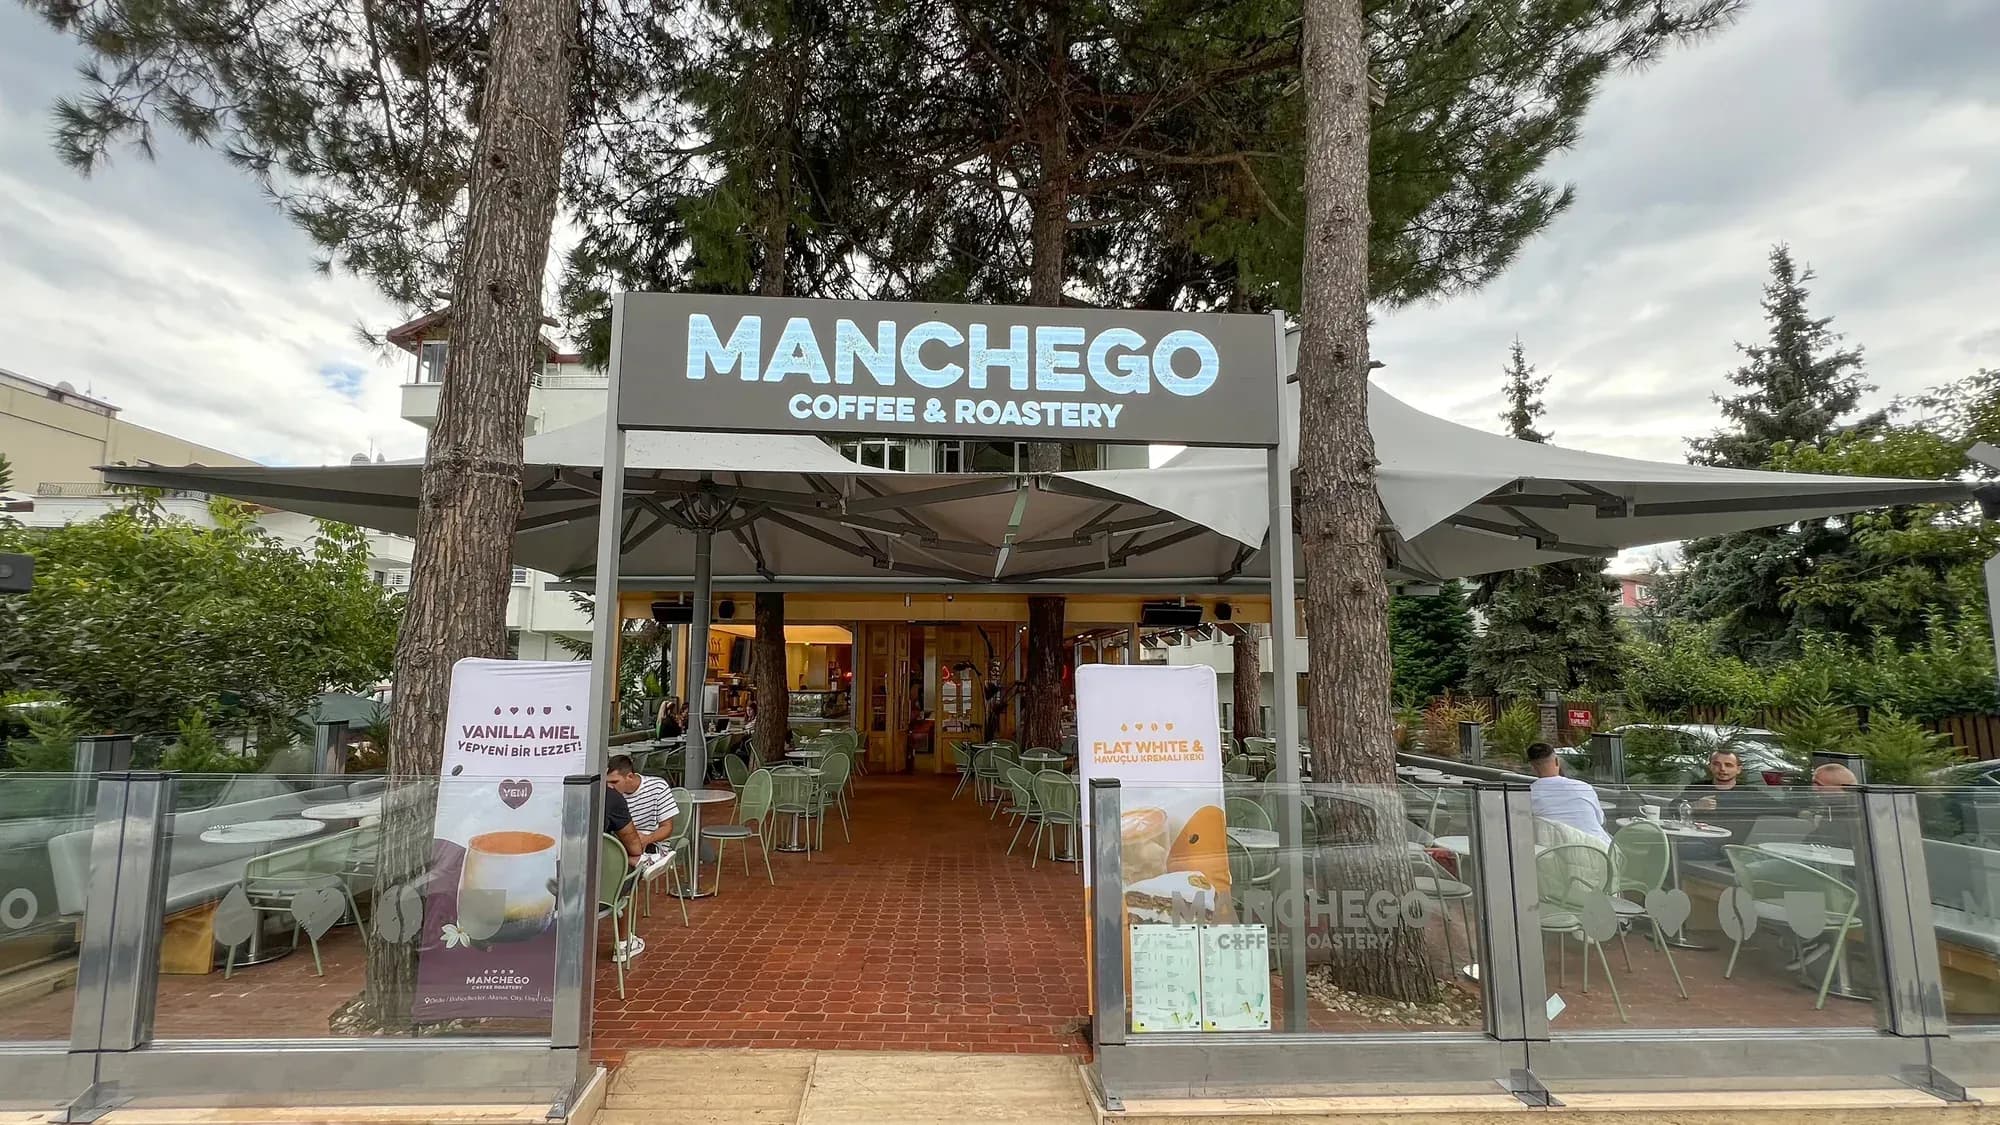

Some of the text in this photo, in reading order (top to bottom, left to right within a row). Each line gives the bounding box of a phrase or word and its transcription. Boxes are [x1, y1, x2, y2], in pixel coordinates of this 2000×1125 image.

[686, 313, 1220, 397] MANCHEGO
[788, 393, 1124, 429] COFFEE & ROASTERY
[462, 725, 579, 739] VANILLA MIEL
[458, 740, 582, 757] YEPYENİ BİR LEZZET!
[1094, 739, 1205, 754] FLAT WHITE &
[1094, 755, 1138, 765] HAVUÇLU
[1140, 753, 1181, 762] KREMALI
[503, 787, 528, 798] YENİ
[1171, 889, 1428, 928] MANCHEGO
[1306, 933, 1390, 949] OASTERY
[465, 976, 530, 985] MANCHEGO
